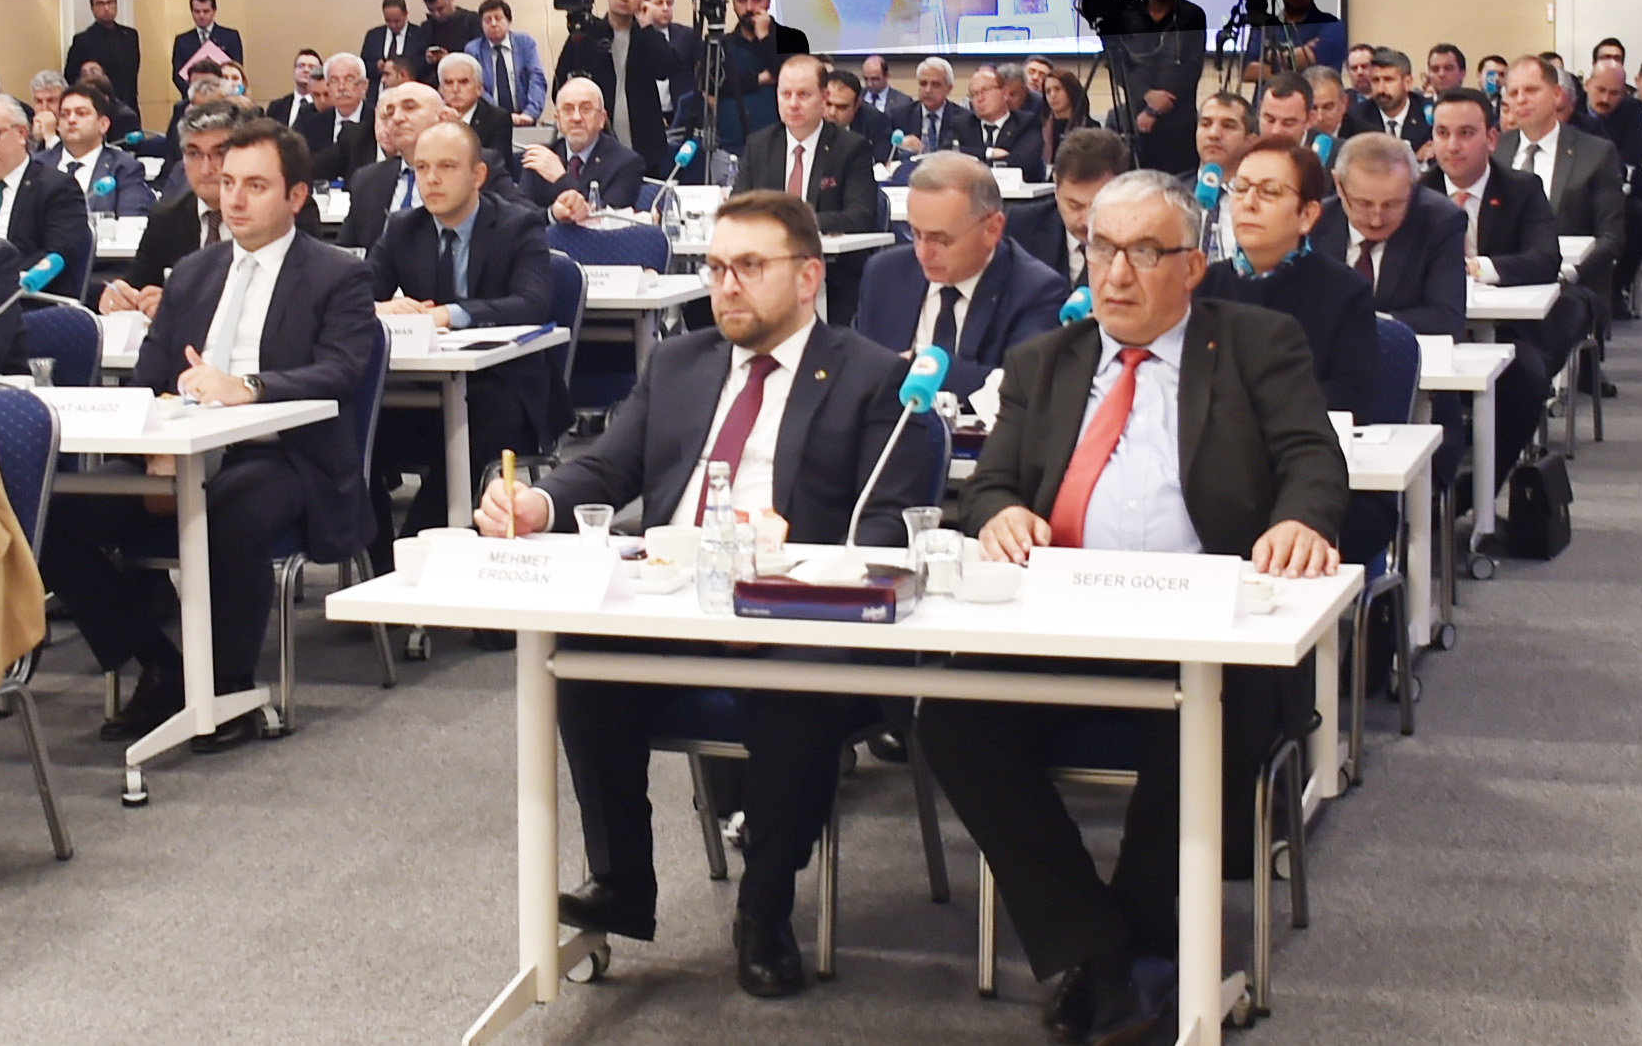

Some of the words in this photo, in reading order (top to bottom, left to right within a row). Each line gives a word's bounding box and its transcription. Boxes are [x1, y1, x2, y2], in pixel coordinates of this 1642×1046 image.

[489, 551, 552, 567] MEHMET
[478, 567, 552, 584] ERDOĞAN
[1072, 572, 1125, 587] SEFER
[1130, 575, 1190, 591] GÖÇER
